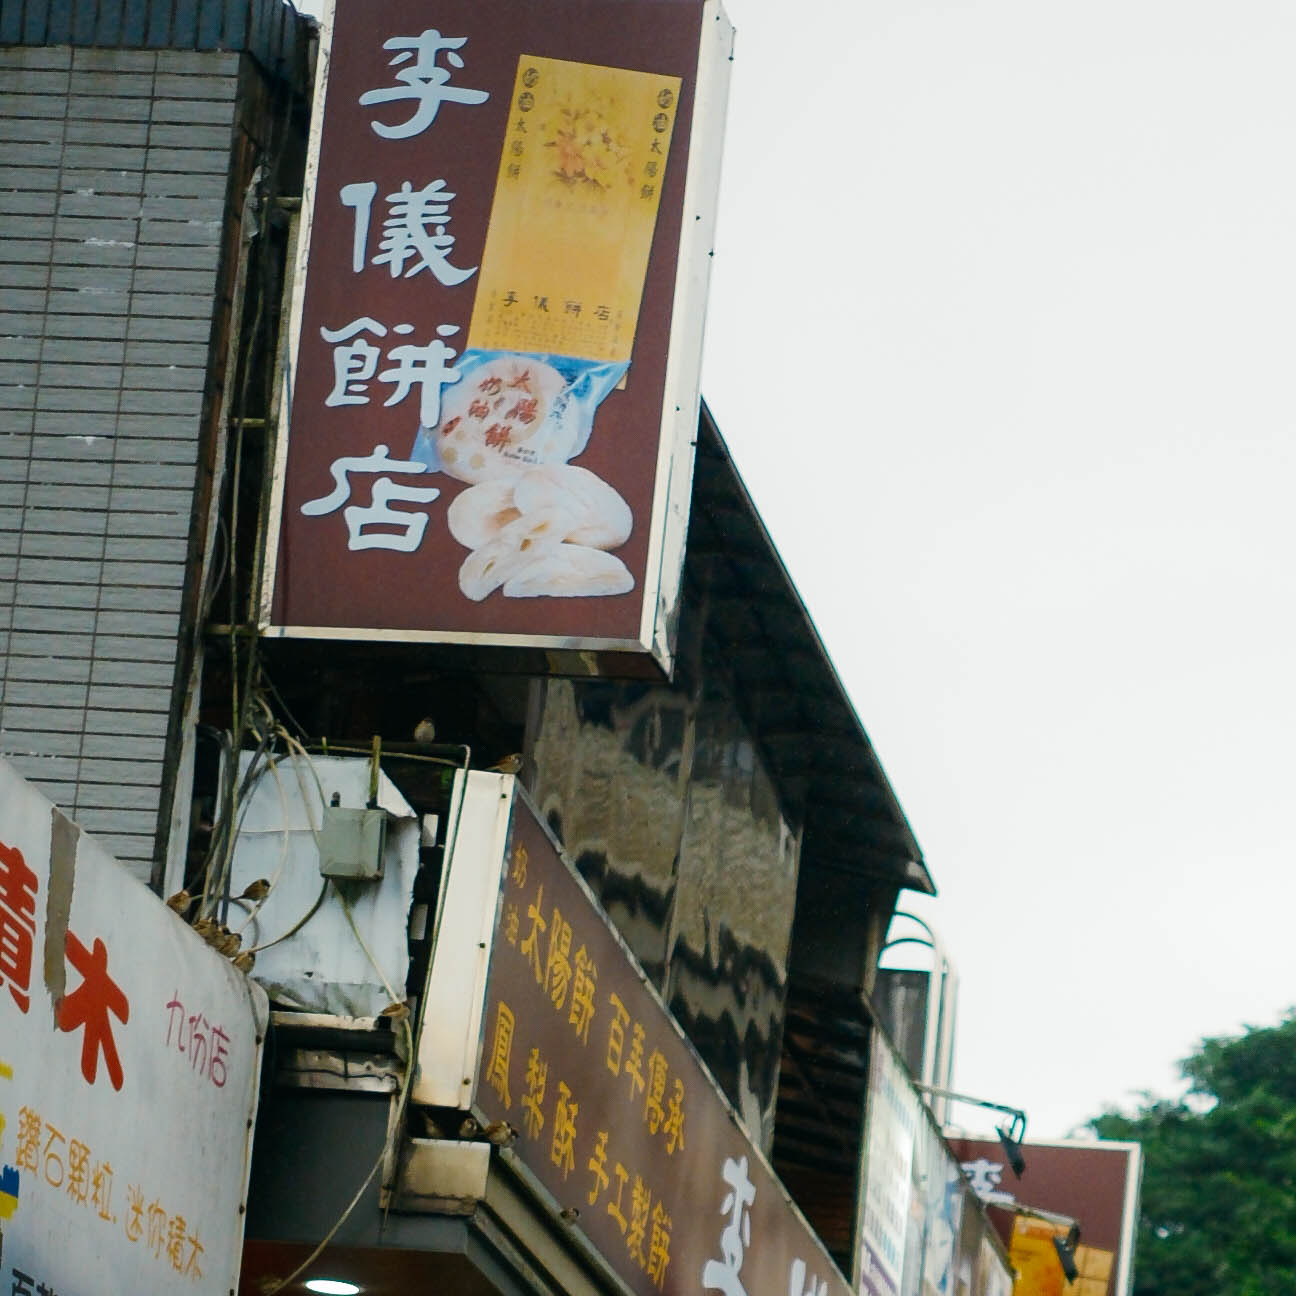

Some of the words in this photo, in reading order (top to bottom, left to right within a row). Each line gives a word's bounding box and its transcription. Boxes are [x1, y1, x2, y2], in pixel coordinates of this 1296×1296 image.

[301, 28, 489, 553] 李儀餅店
[166, 988, 231, 1088] 九份店
[520, 884, 598, 1046] 太陽餅
[487, 1001, 579, 1180] 鳳梨酥
[588, 1131, 672, 1292] 手工製餅
